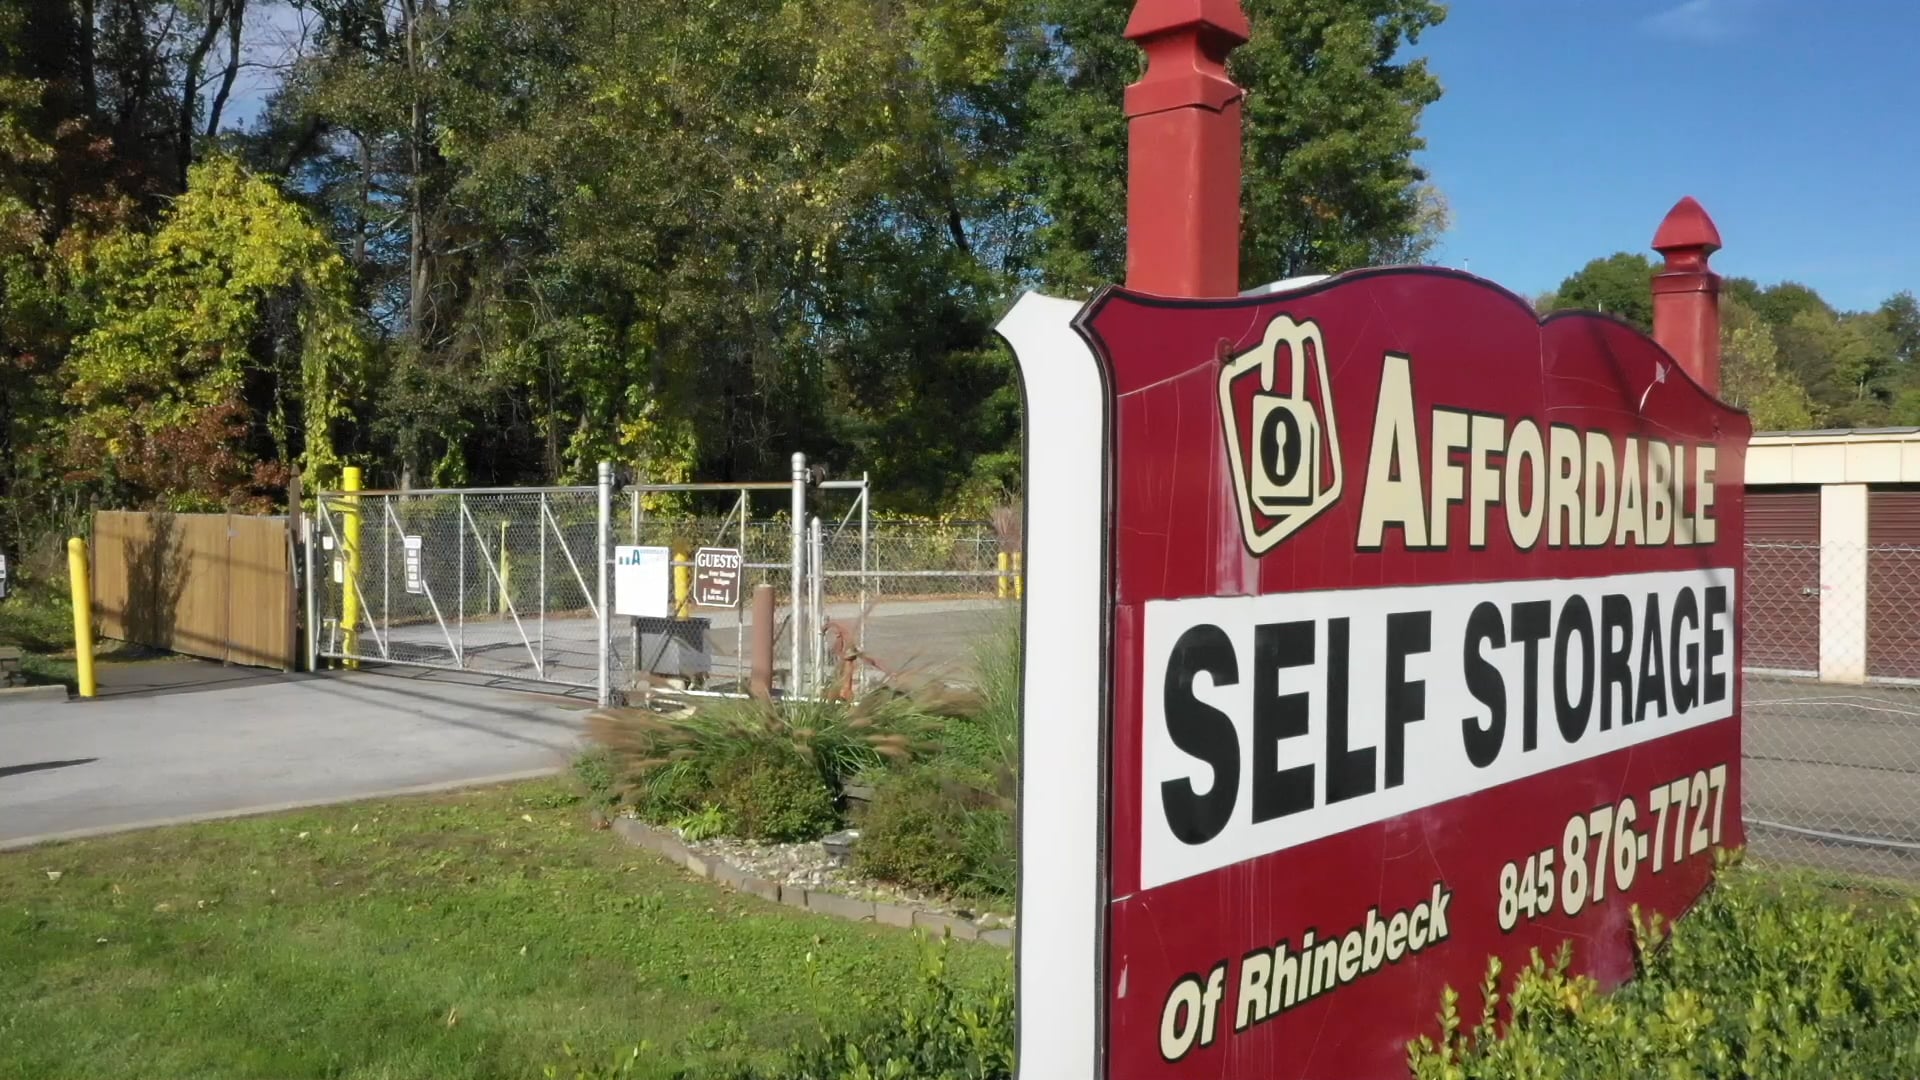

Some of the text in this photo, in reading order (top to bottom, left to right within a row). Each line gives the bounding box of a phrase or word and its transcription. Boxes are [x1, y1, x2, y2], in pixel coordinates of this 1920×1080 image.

[1356, 351, 1720, 550] AFFORDABLE
[698, 553, 739, 568] GUESTS
[1161, 585, 1728, 846] SELF STORAGE
[1498, 765, 1727, 931] 845 876-7727
[1160, 882, 1451, 1062] Of Rhinebeck
